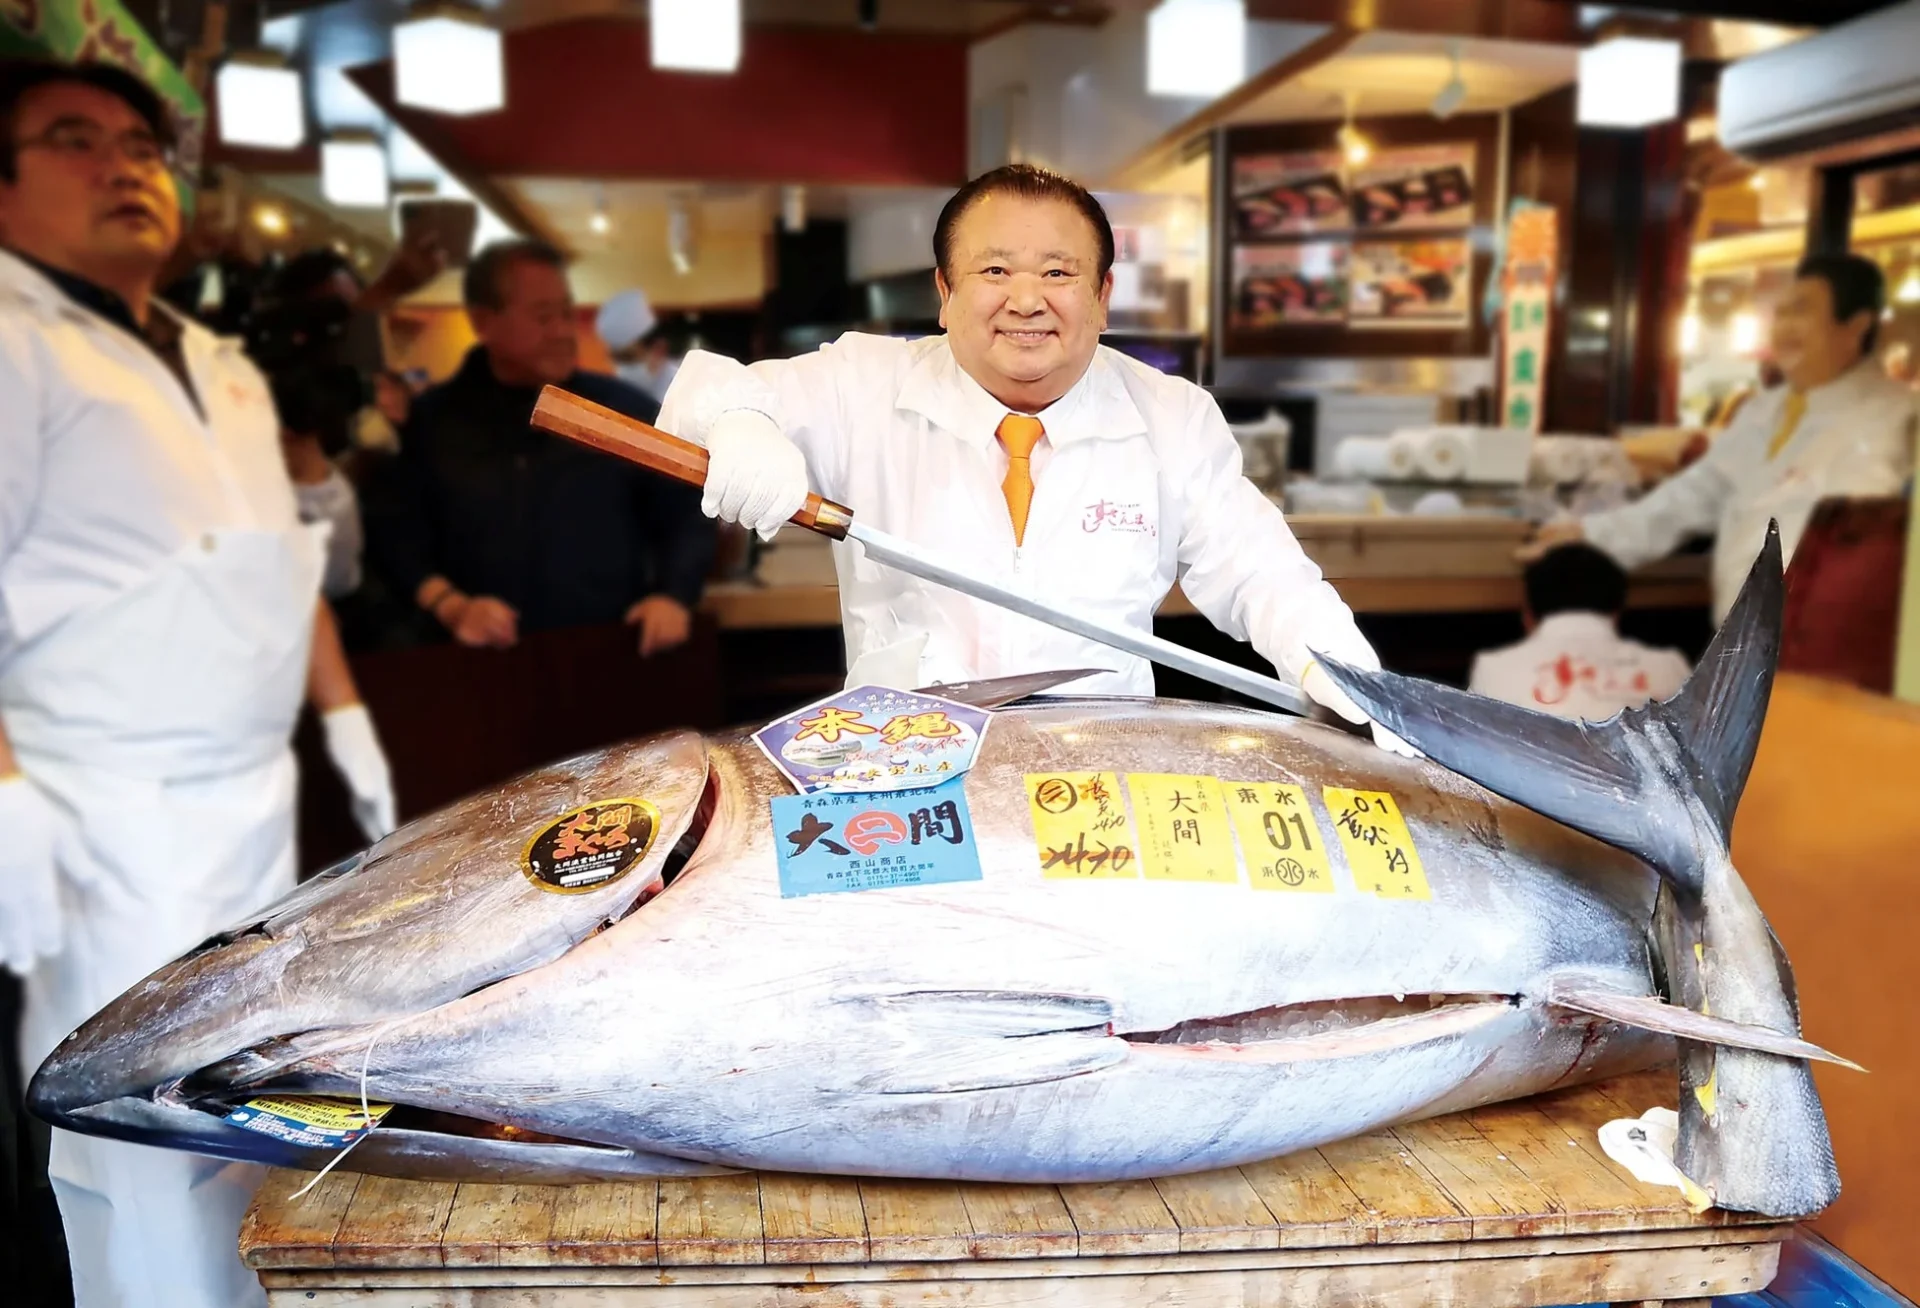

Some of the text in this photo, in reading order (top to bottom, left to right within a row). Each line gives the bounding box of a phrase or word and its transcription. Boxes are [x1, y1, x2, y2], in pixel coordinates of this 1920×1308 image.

[1167, 789, 1202, 846] 大間
[1262, 811, 1313, 851] 01
[848, 855, 908, 869] 西山商店
